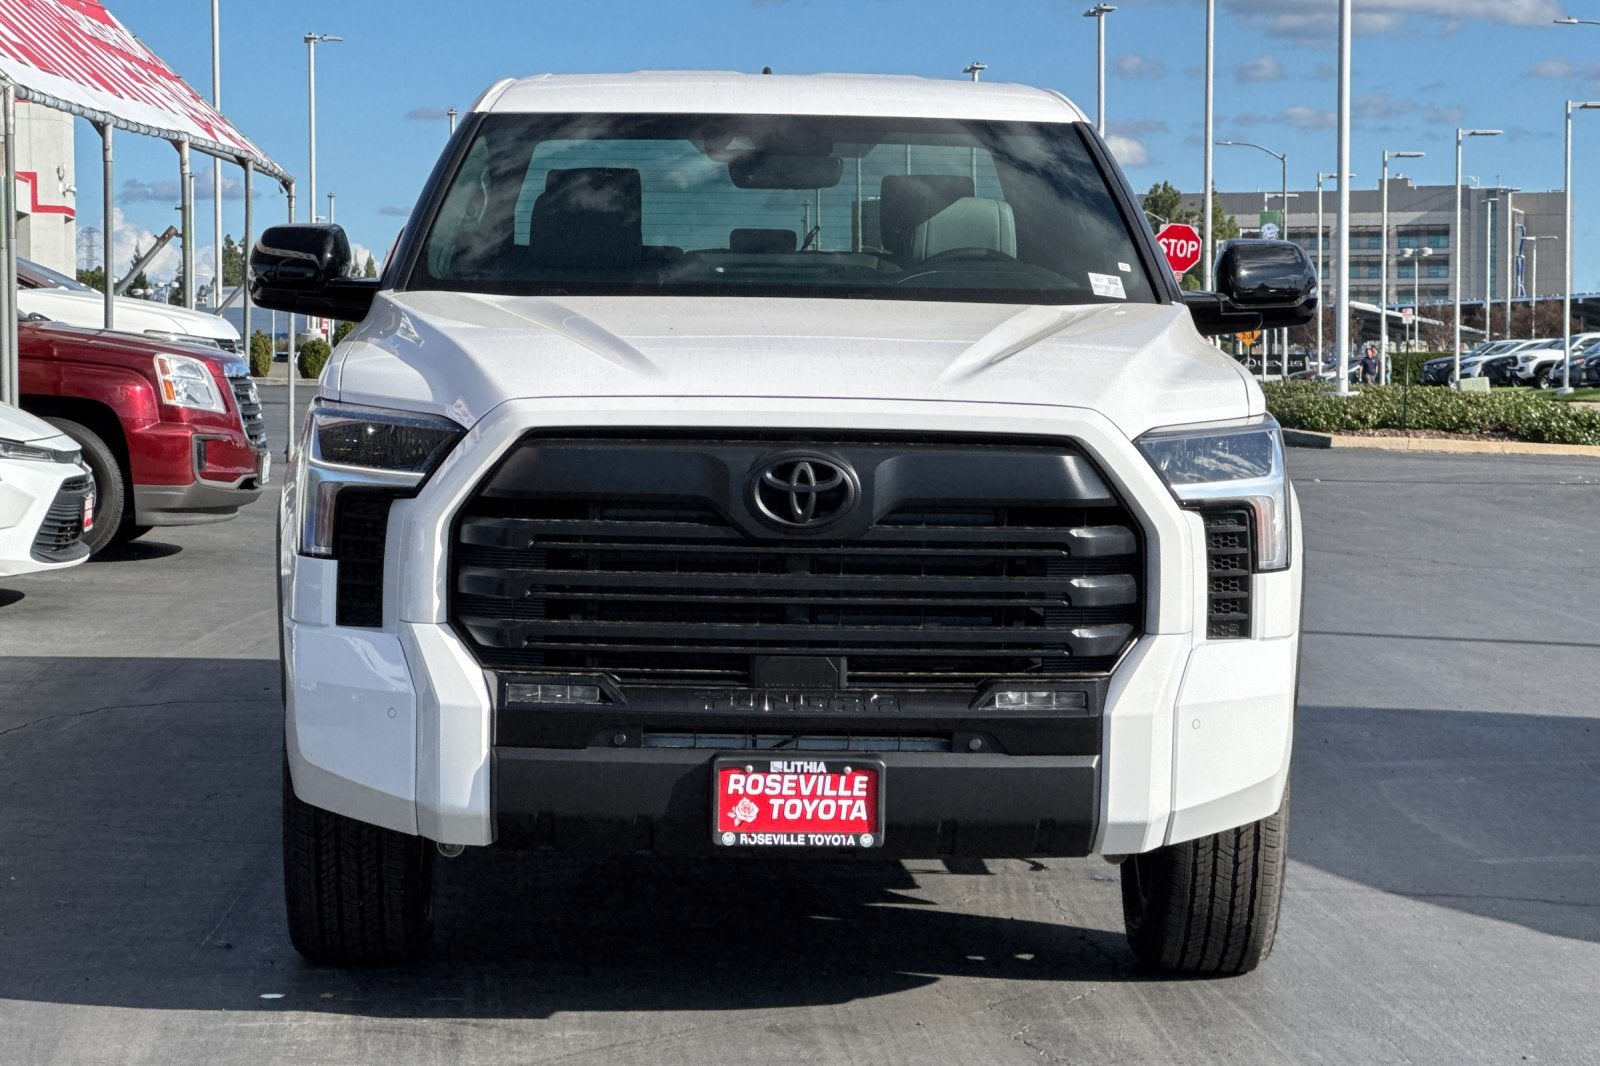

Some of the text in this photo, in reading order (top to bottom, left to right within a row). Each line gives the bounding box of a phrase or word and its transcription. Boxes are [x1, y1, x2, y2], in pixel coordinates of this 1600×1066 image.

[1158, 238, 1199, 258] STOP
[698, 691, 900, 711] TUNDRA
[784, 761, 827, 773] LITHIA
[727, 774, 869, 797] ROSEVILLE
[769, 798, 868, 821] TOYOTA
[740, 833, 856, 846] ROSEVILLE TOYOTA
